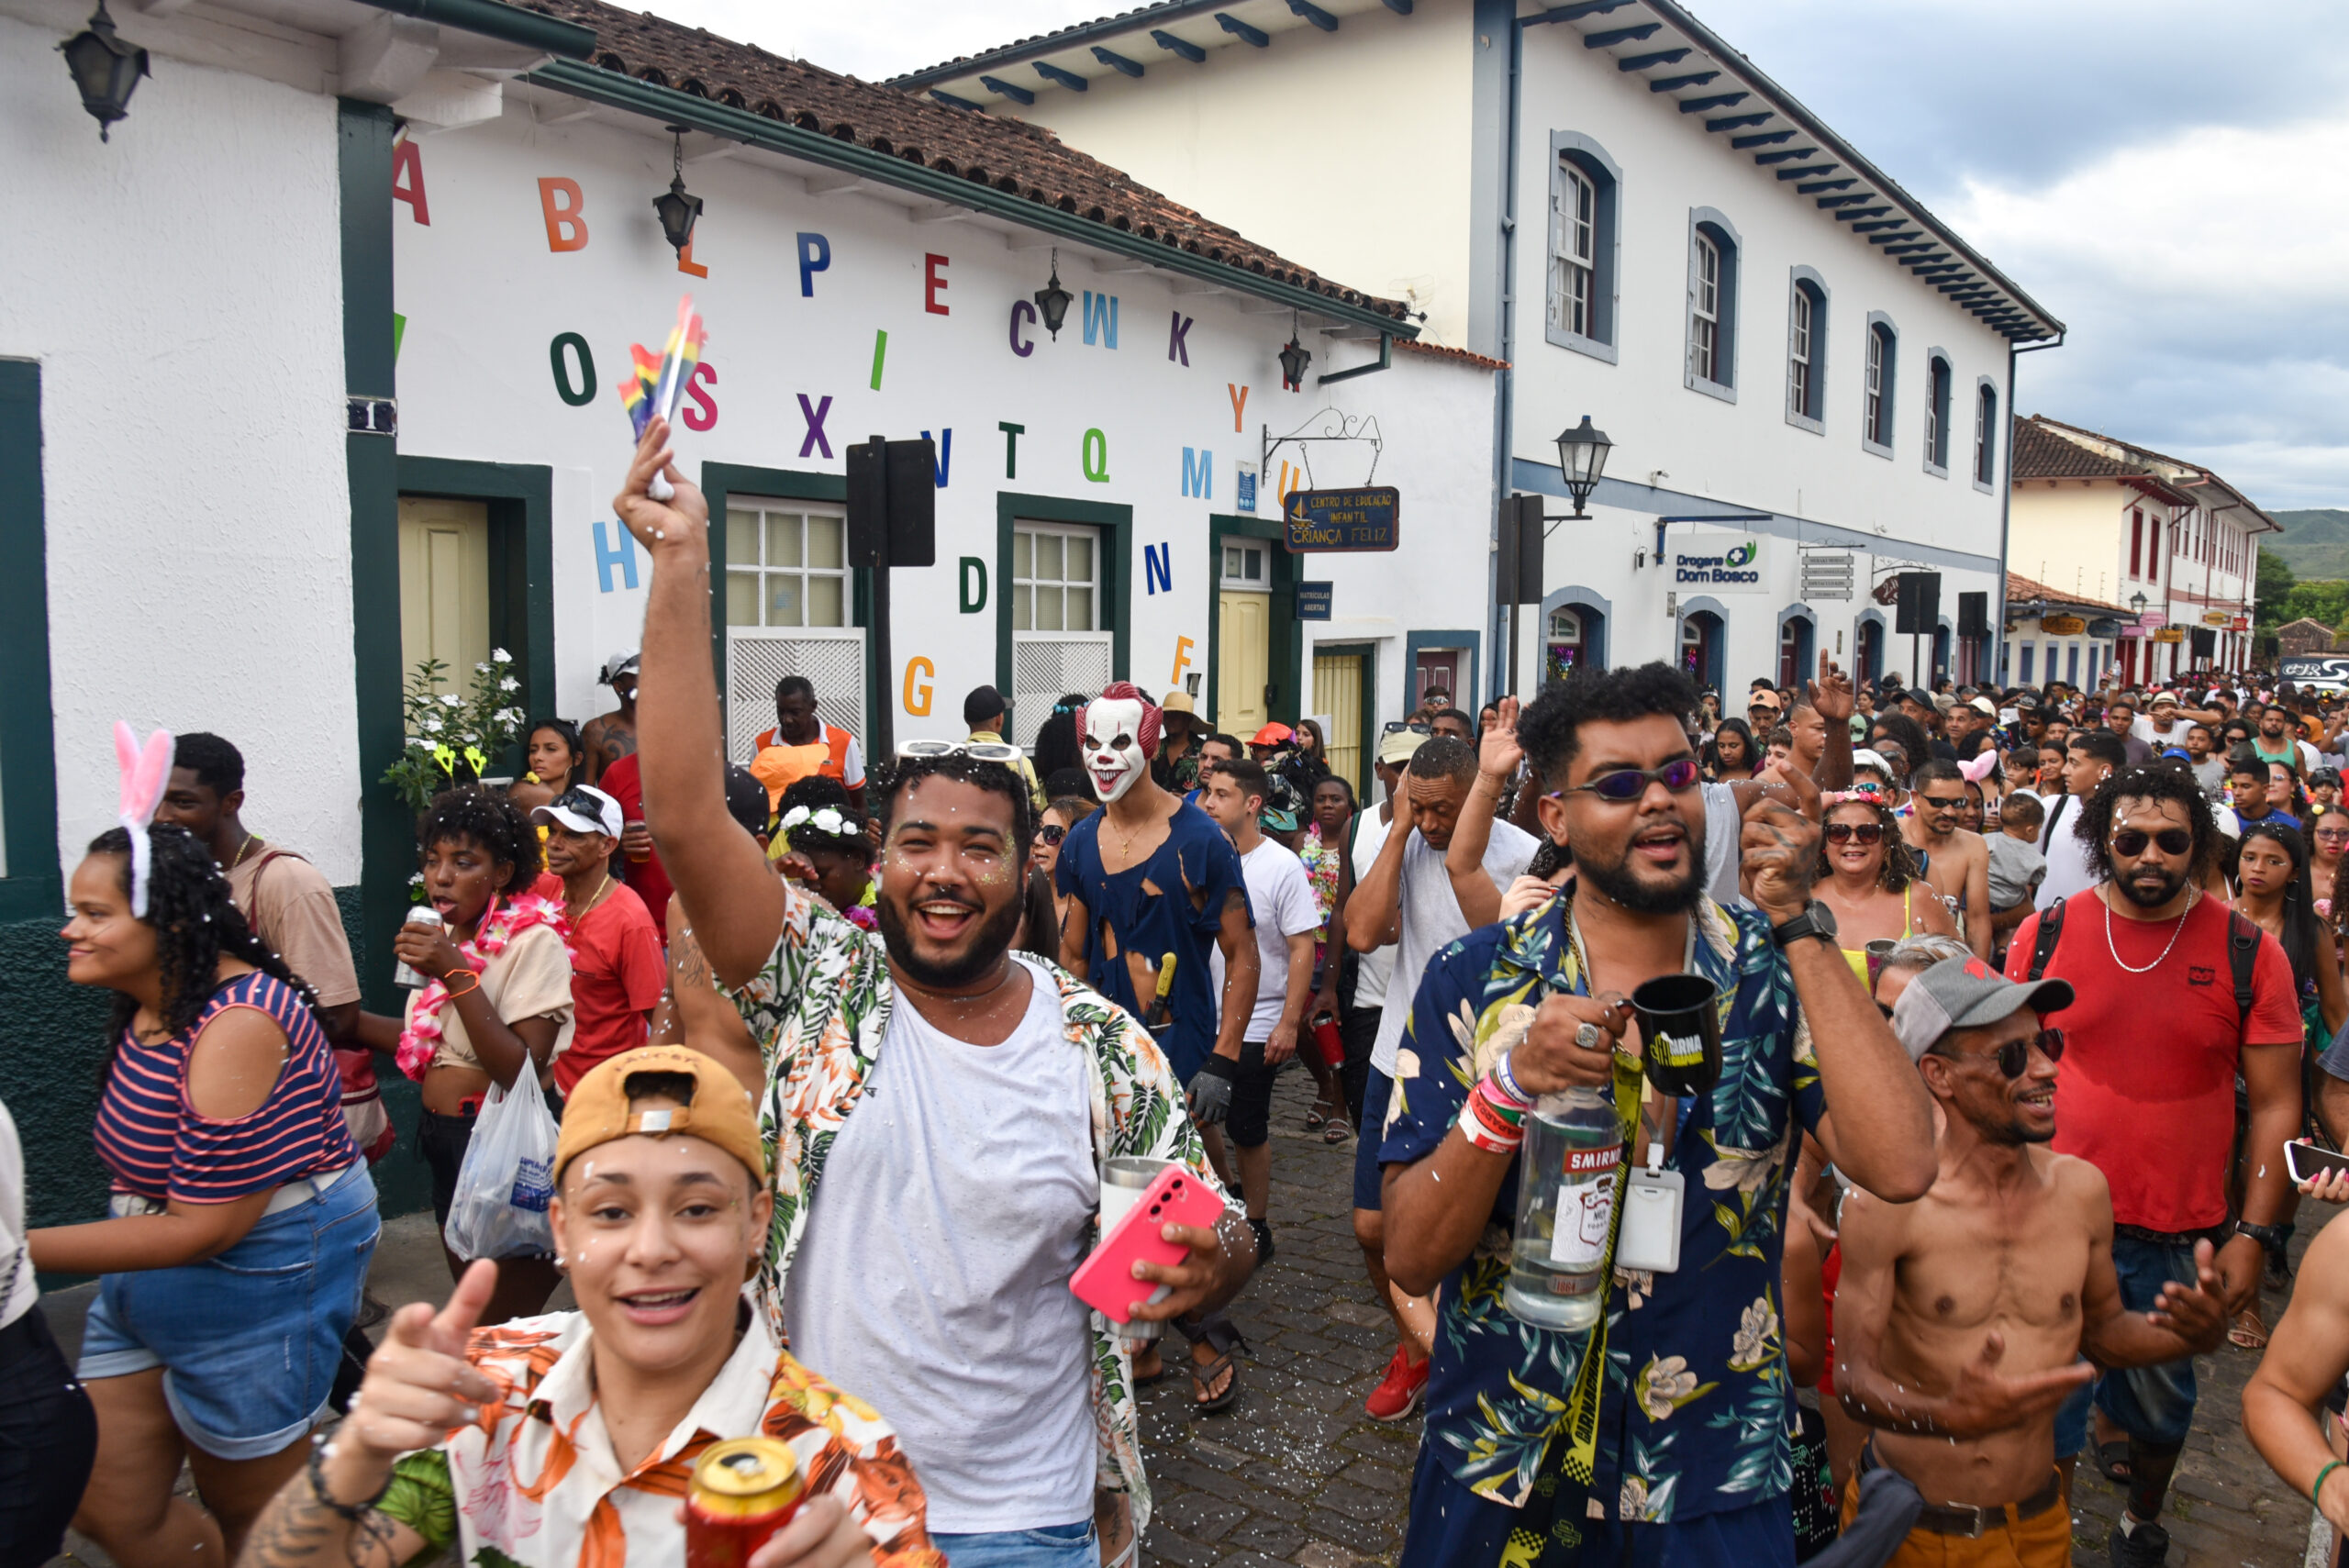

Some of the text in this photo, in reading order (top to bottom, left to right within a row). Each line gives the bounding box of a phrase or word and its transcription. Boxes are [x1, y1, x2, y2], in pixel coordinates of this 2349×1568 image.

[393, 139, 430, 227] A
[538, 177, 588, 252] B
[796, 232, 830, 297] P
[925, 252, 950, 316] E
[1009, 299, 1037, 358] C
[1083, 289, 1119, 350] W
[1168, 310, 1194, 367] K
[550, 331, 597, 406] O
[870, 329, 887, 391] I
[365, 401, 377, 429] 1
[681, 361, 718, 432] S
[1227, 383, 1249, 432] Y
[796, 393, 834, 459] X
[998, 421, 1025, 480] T
[1083, 428, 1109, 484] Q
[1182, 447, 1212, 499] M
[1310, 492, 1392, 508] CENTRO DE EDUCAÇÃO
[1330, 510, 1368, 524] INFANTIL
[592, 519, 640, 593] H
[1292, 527, 1388, 545] CRIANÇA FELIZ
[959, 556, 988, 614] D
[1144, 541, 1172, 595] N
[1675, 568, 1759, 583] Dom Bosco
[1304, 604, 1326, 612] ABERTAS
[903, 655, 935, 717] G
[1171, 635, 1194, 685] F
